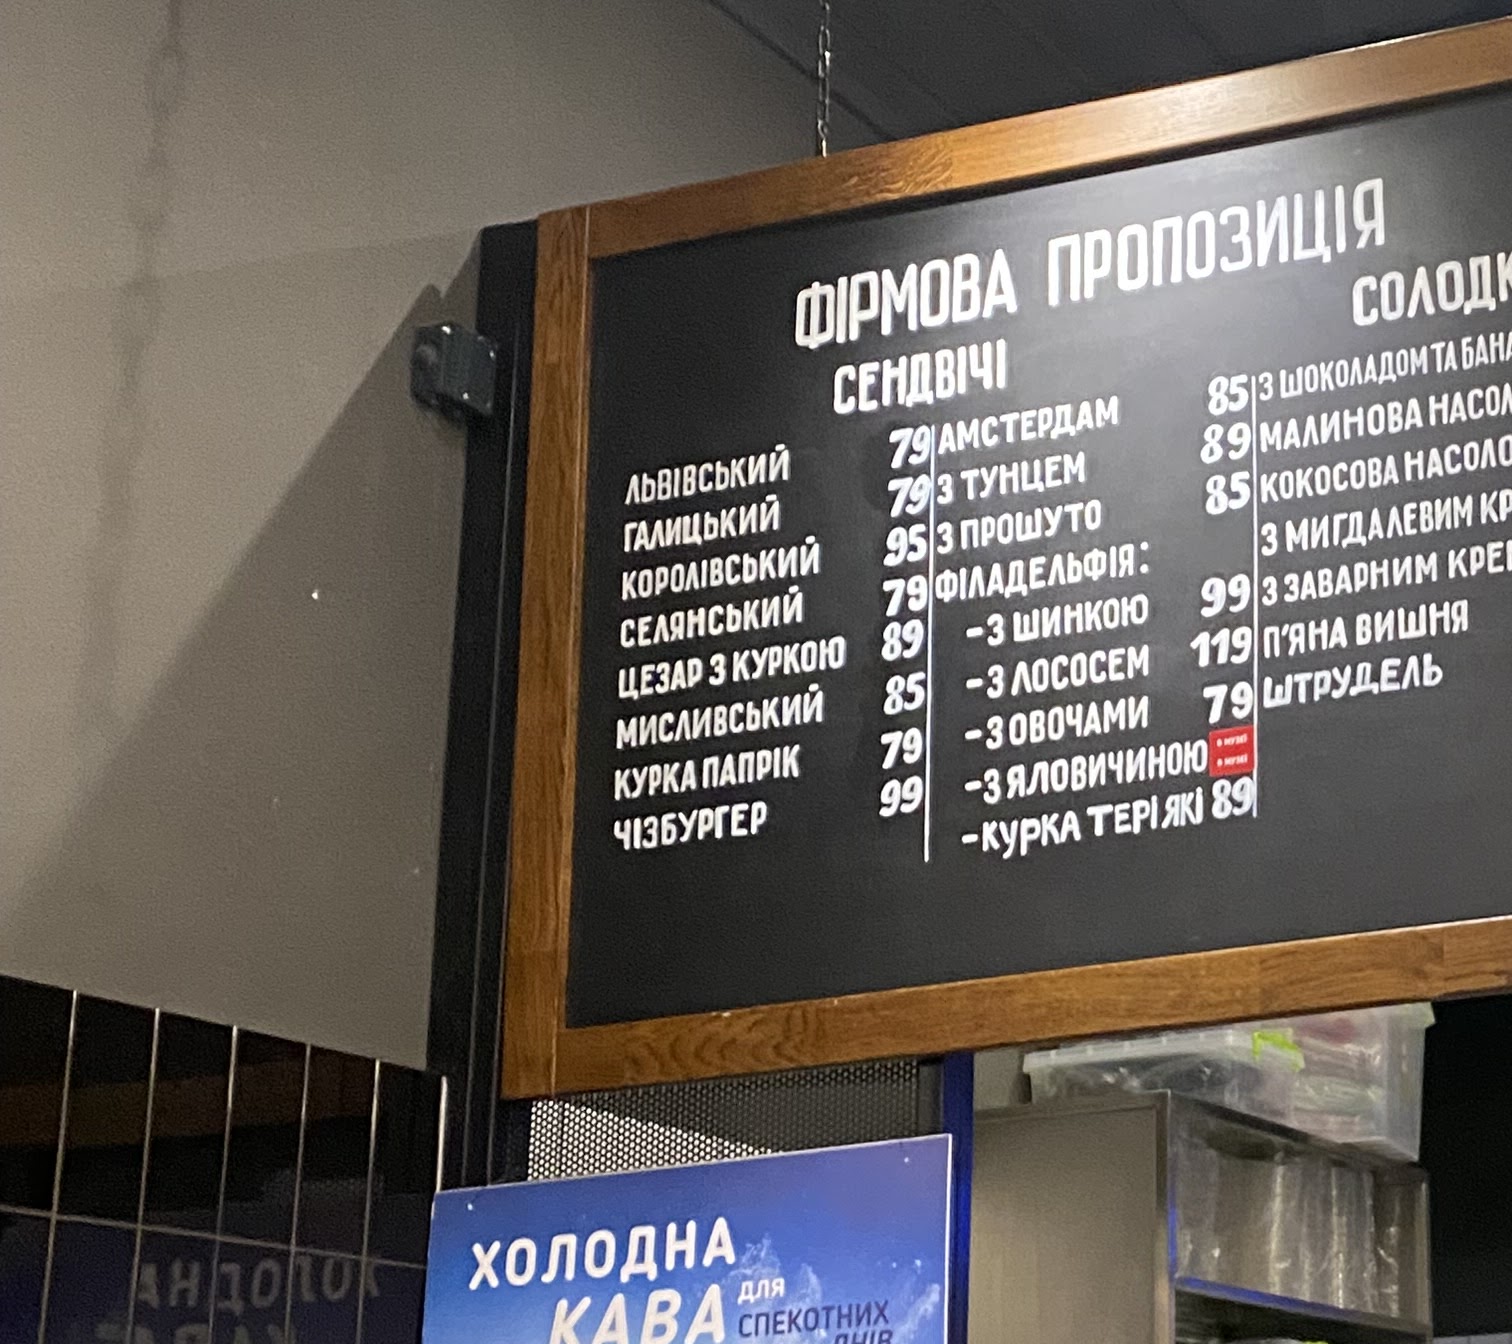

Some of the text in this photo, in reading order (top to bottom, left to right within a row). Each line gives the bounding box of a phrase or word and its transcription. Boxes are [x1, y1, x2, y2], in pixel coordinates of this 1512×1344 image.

[794, 178, 1387, 349] ФІРМОВА ПРОПОЗИЦІЯ
[833, 339, 1007, 414] СЕНДВІЧІ
[1279, 350, 1428, 397] ШОКОЛАДОМ
[938, 374, 1250, 455] АМСТЕРДАМ 85
[1260, 403, 1424, 454] МАЛИНОВА
[625, 427, 931, 505] ЛЬВІВСЬКИЙ 79
[960, 422, 1252, 503] ТУНЦЕМ 89
[1260, 454, 1400, 504] КОКОСОВА
[623, 478, 930, 554] ГАЛИЦЬКИЙ 79
[960, 473, 1252, 549] ПРОШУТО 85
[1284, 502, 1471, 554] МИГДАЛЕВИМ
[621, 528, 928, 601] КОРОЛІВСЬКИЙ 95
[1282, 556, 1439, 604] ЗАВАРНИМ
[620, 578, 929, 649] СЕЛЯНСЬКИЙ 79
[1013, 578, 1252, 641] ШИНКОЮ 99
[1355, 598, 1469, 646] ВИШНЯ
[619, 622, 925, 700] ЦЕЗАР КУРКОЮ 89
[1010, 627, 1252, 696] ЛОСОСЕМ 119
[1262, 655, 1444, 709] ШТРУДЕЛЬ
[616, 673, 926, 750] МИСЛИВСЬКИЙ 85
[1008, 682, 1254, 745] ОВОЧАМИ 79
[614, 728, 923, 800] КУРКА ПАПРІК 79
[1006, 739, 1208, 800] ЯЛОВИЧИНОЮ
[1212, 777, 1254, 820] 89
[614, 776, 924, 851] ЧІЗБУРГЕР 99
[468, 1217, 737, 1292] ХОЛОДНА
[738, 1277, 786, 1304] ДЛЯ
[738, 1300, 890, 1340] СПЕКОТНИХ
